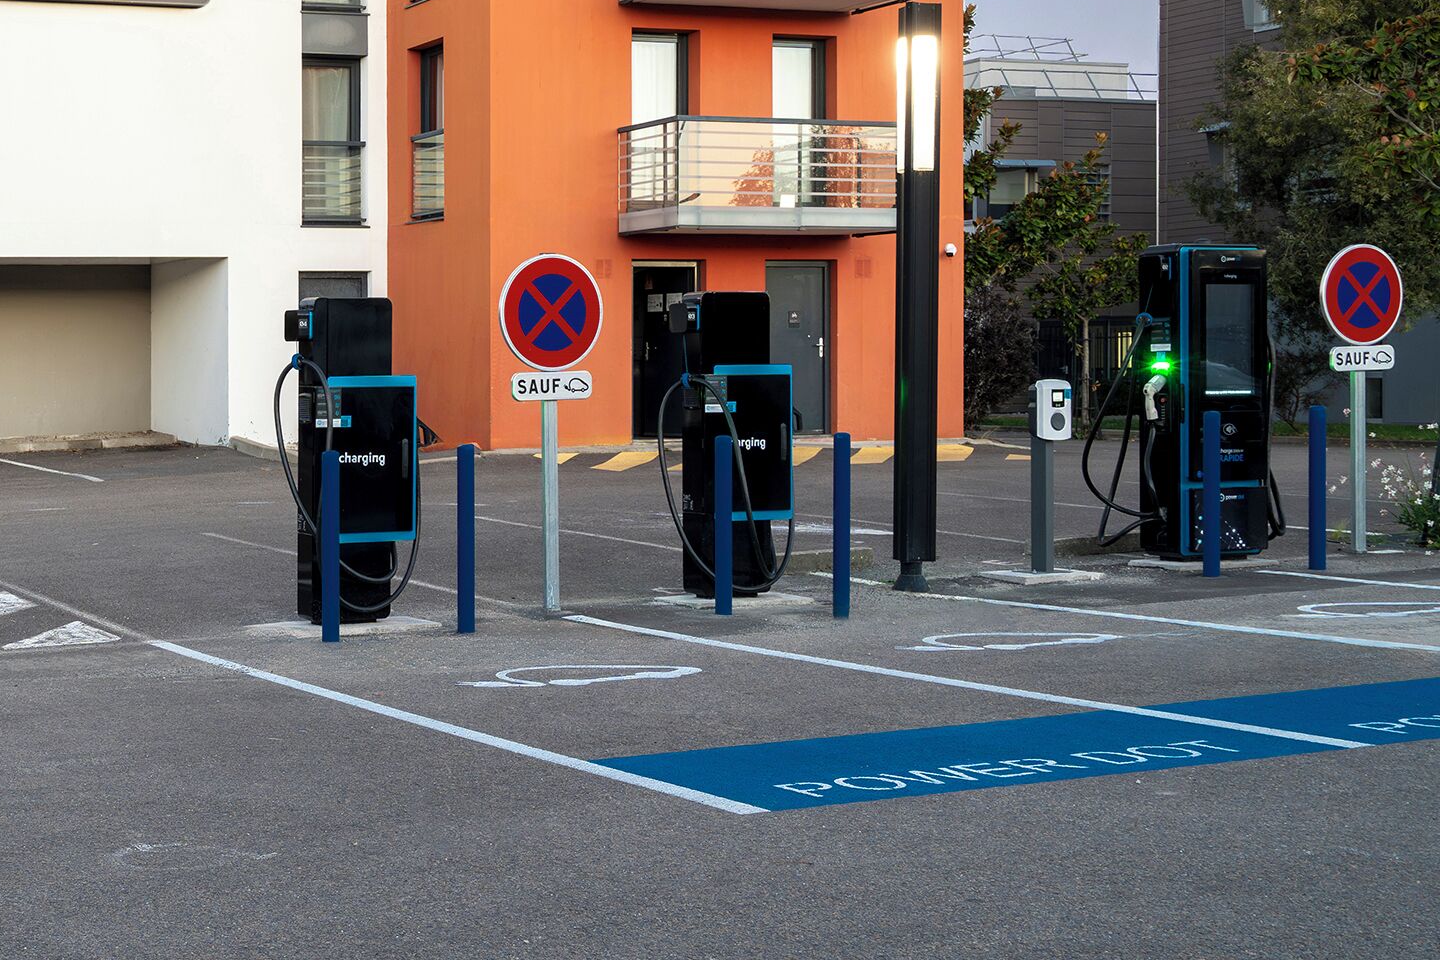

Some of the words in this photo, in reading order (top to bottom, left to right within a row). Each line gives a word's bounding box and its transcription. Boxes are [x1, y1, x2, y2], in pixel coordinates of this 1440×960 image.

[1336, 352, 1369, 365] SAUF
[517, 378, 561, 394] SAUF
[338, 451, 386, 467] charging
[773, 756, 1090, 798] POWER
[1071, 739, 1239, 765] DOT
